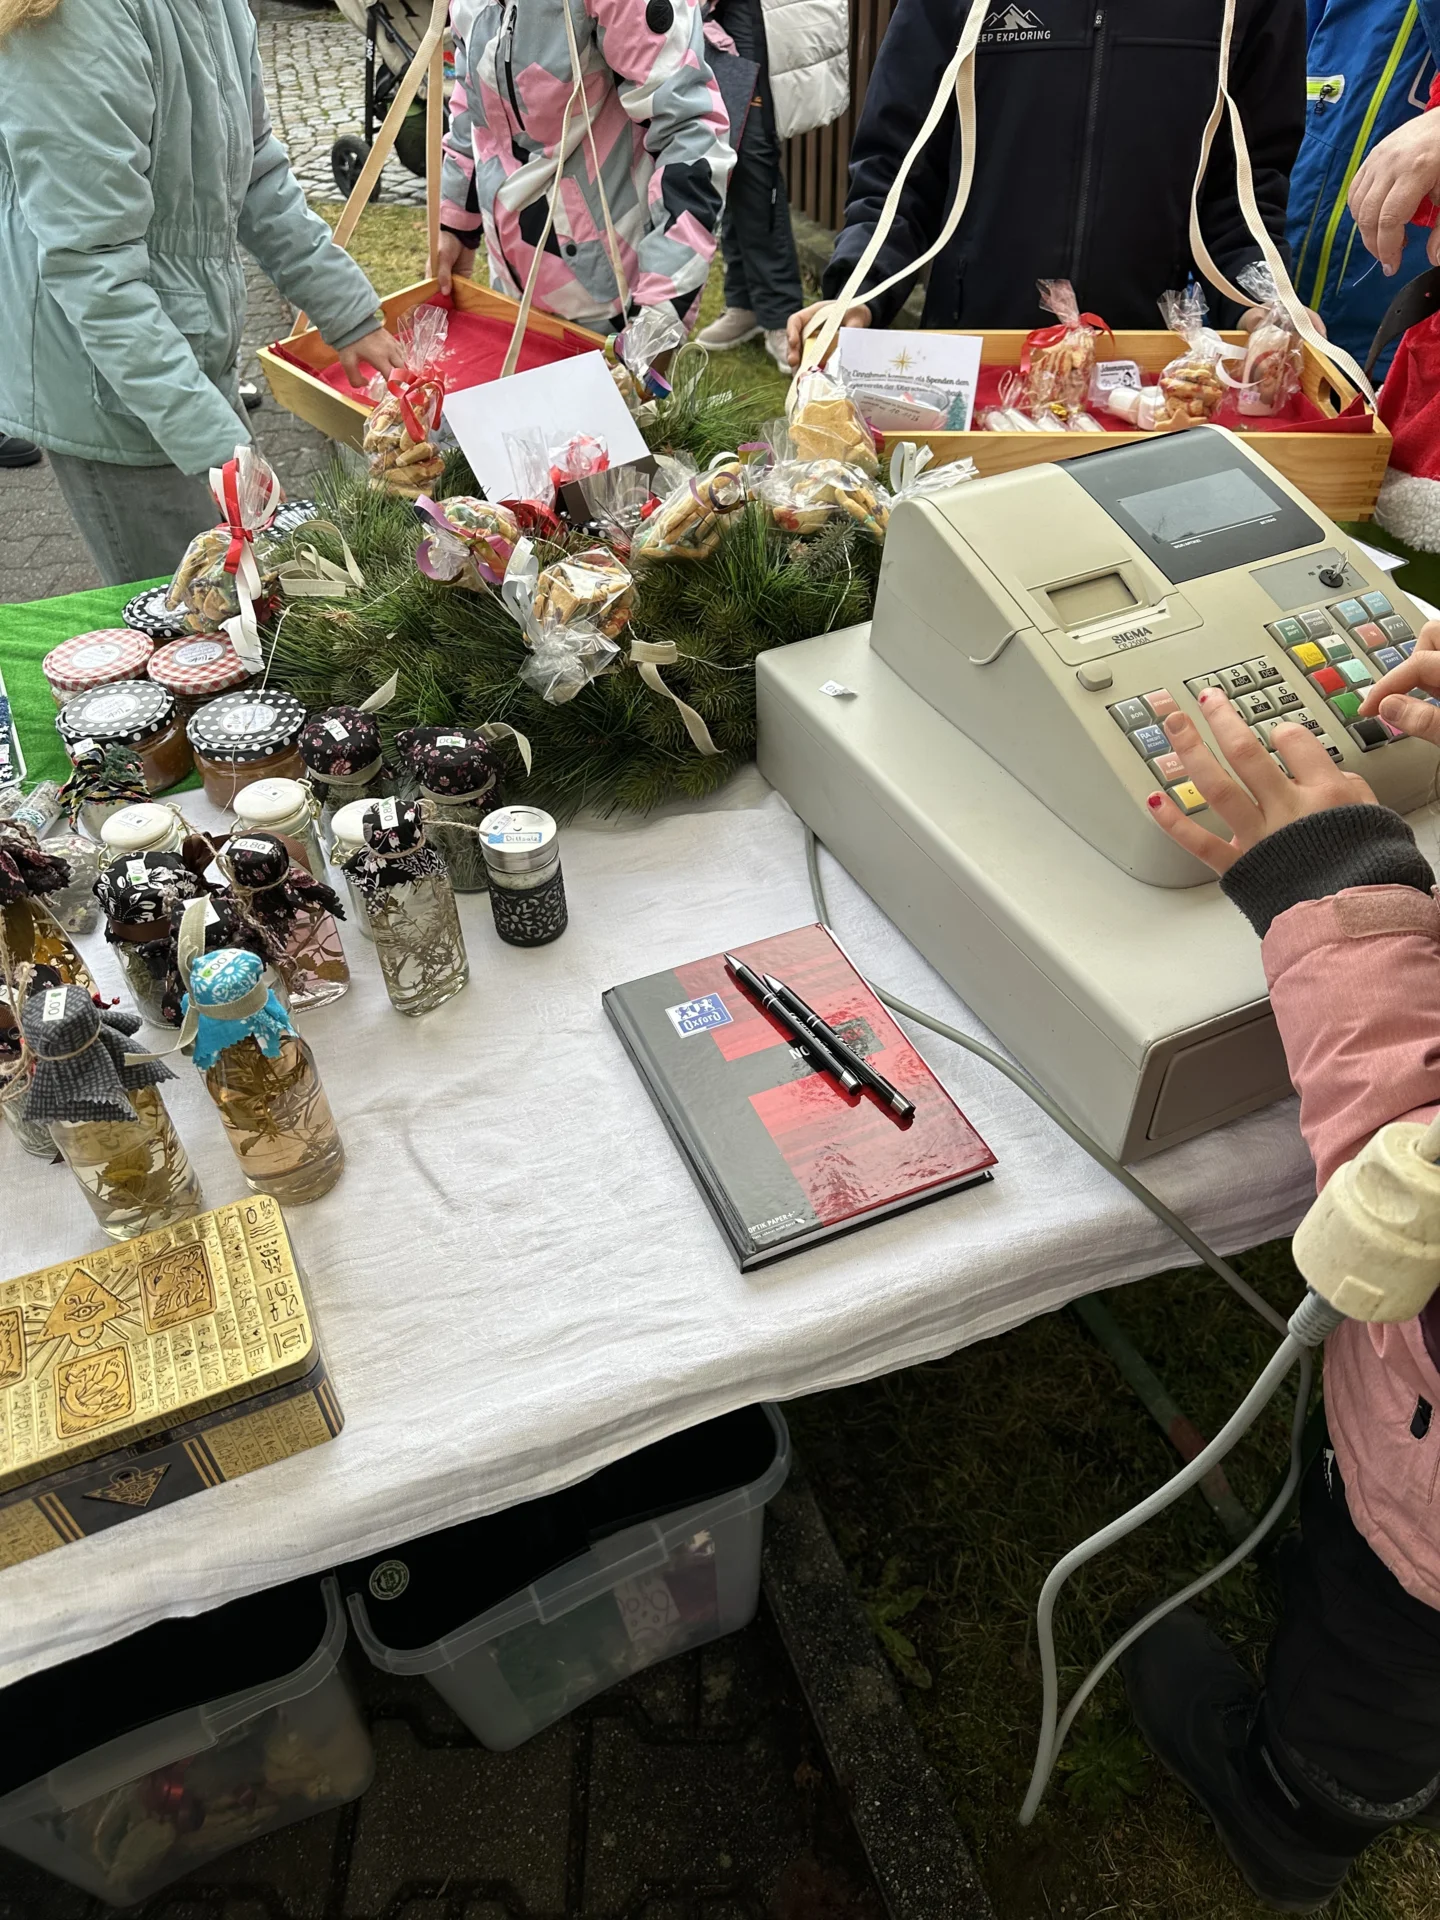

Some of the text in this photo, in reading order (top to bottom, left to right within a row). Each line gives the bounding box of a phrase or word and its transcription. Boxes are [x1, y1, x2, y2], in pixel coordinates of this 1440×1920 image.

[977, 30, 1051, 43] EEP EXPLORING
[1112, 627, 1152, 644] SIGMA
[1258, 661, 1267, 669] 9
[1231, 669, 1240, 677] 8
[1261, 669, 1275, 677] DEF
[1279, 687, 1287, 695] 6
[1251, 695, 1260, 704] 5
[1130, 711, 1143, 719] BON
[1298, 713, 1308, 721] 3
[683, 1011, 722, 1031] Oxford
[747, 1222, 767, 1233] OPTIK
